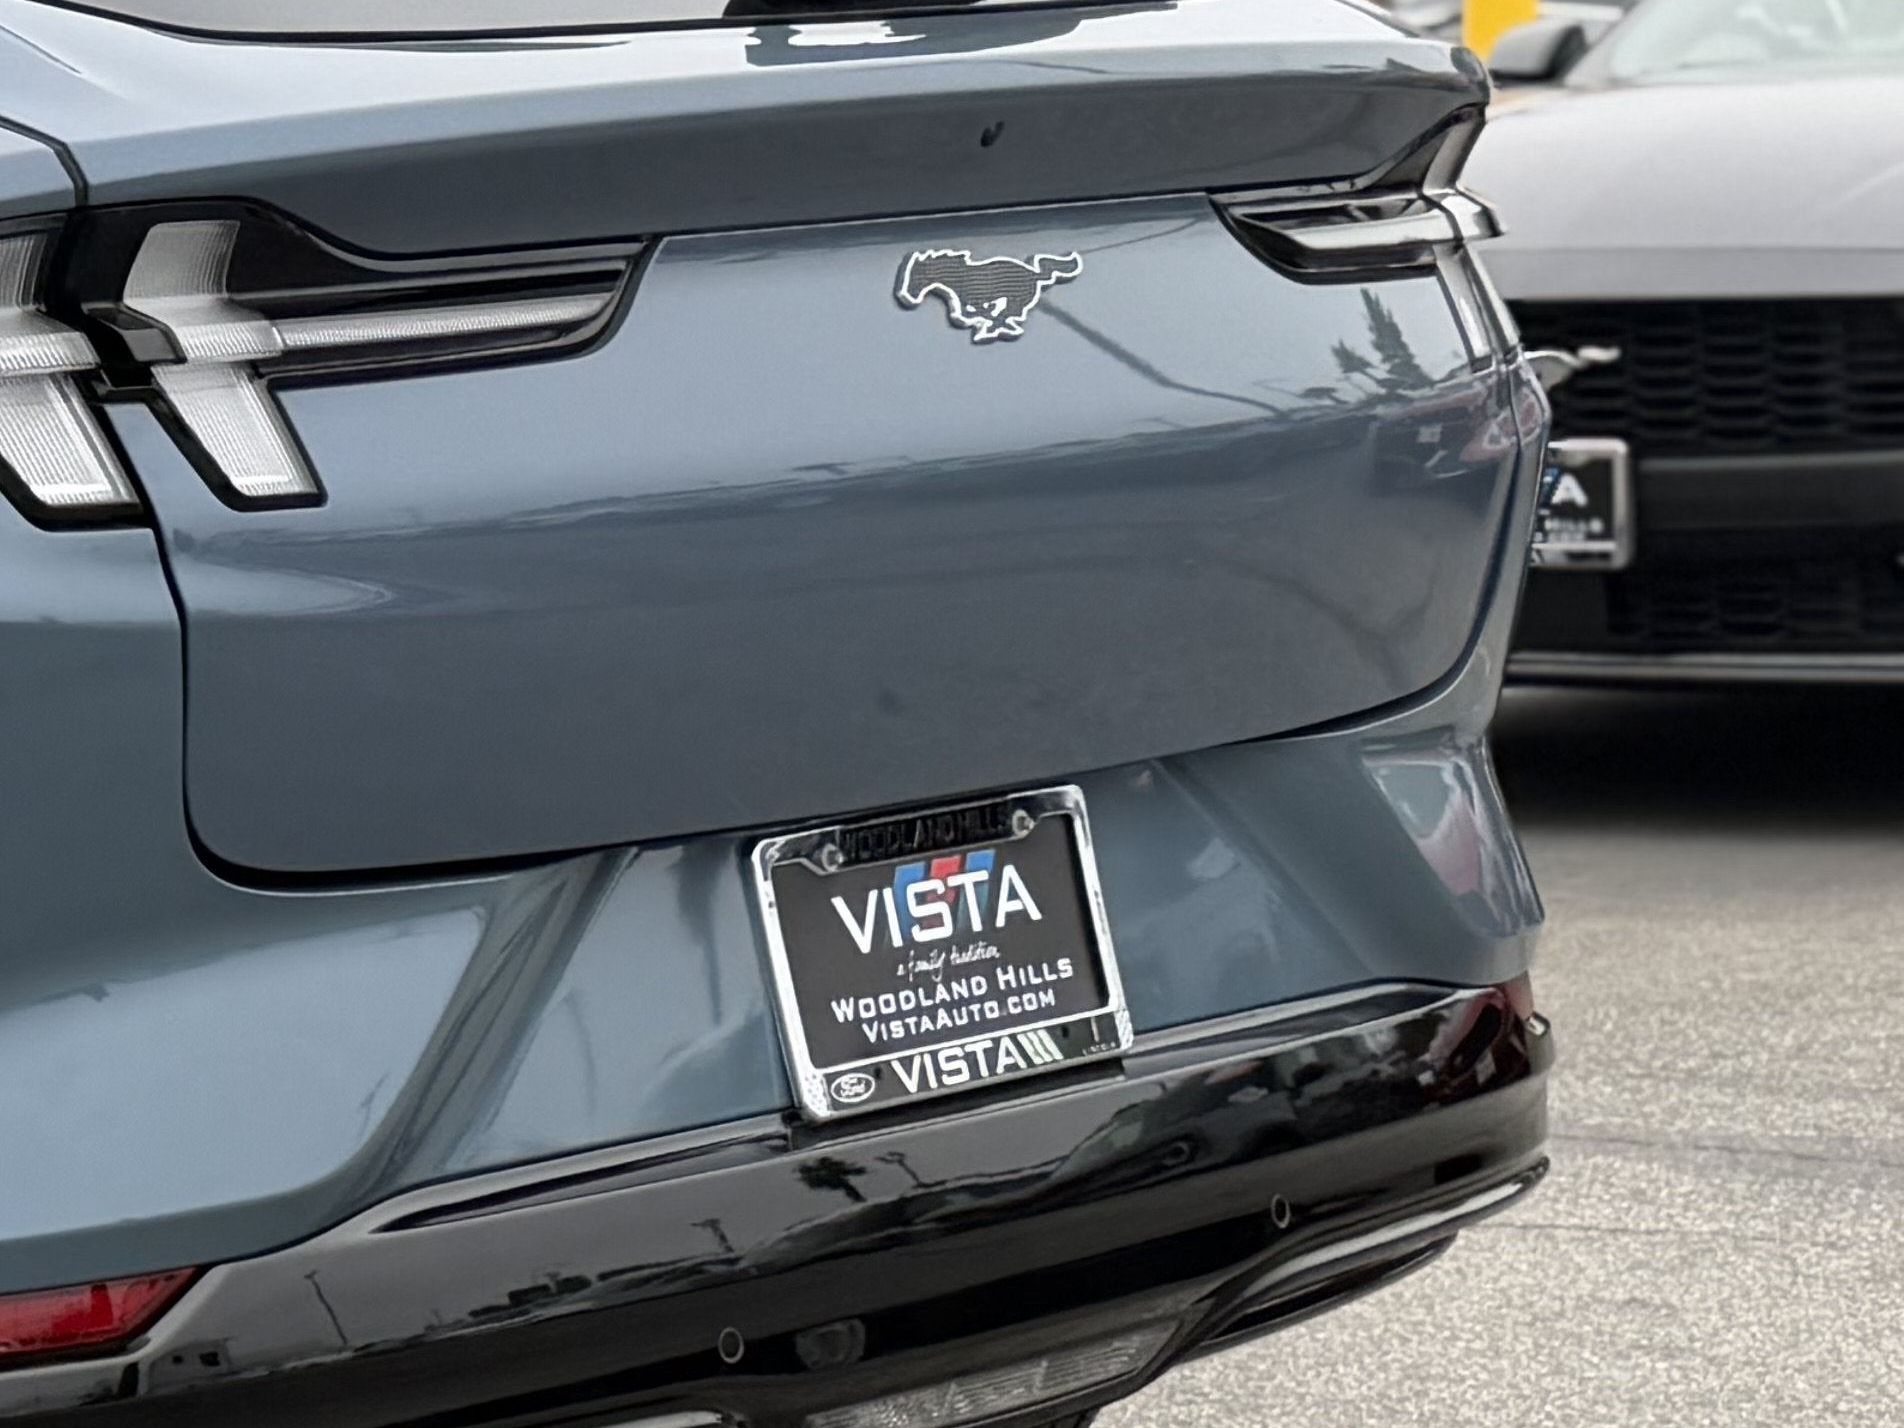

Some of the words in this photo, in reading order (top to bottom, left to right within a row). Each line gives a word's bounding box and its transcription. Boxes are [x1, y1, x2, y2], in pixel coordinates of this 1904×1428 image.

[831, 864, 1042, 954] VISTA
[830, 974, 988, 1023] WOODLAND
[995, 957, 1074, 991] HILLS
[891, 1033, 1027, 1094] VISTA
